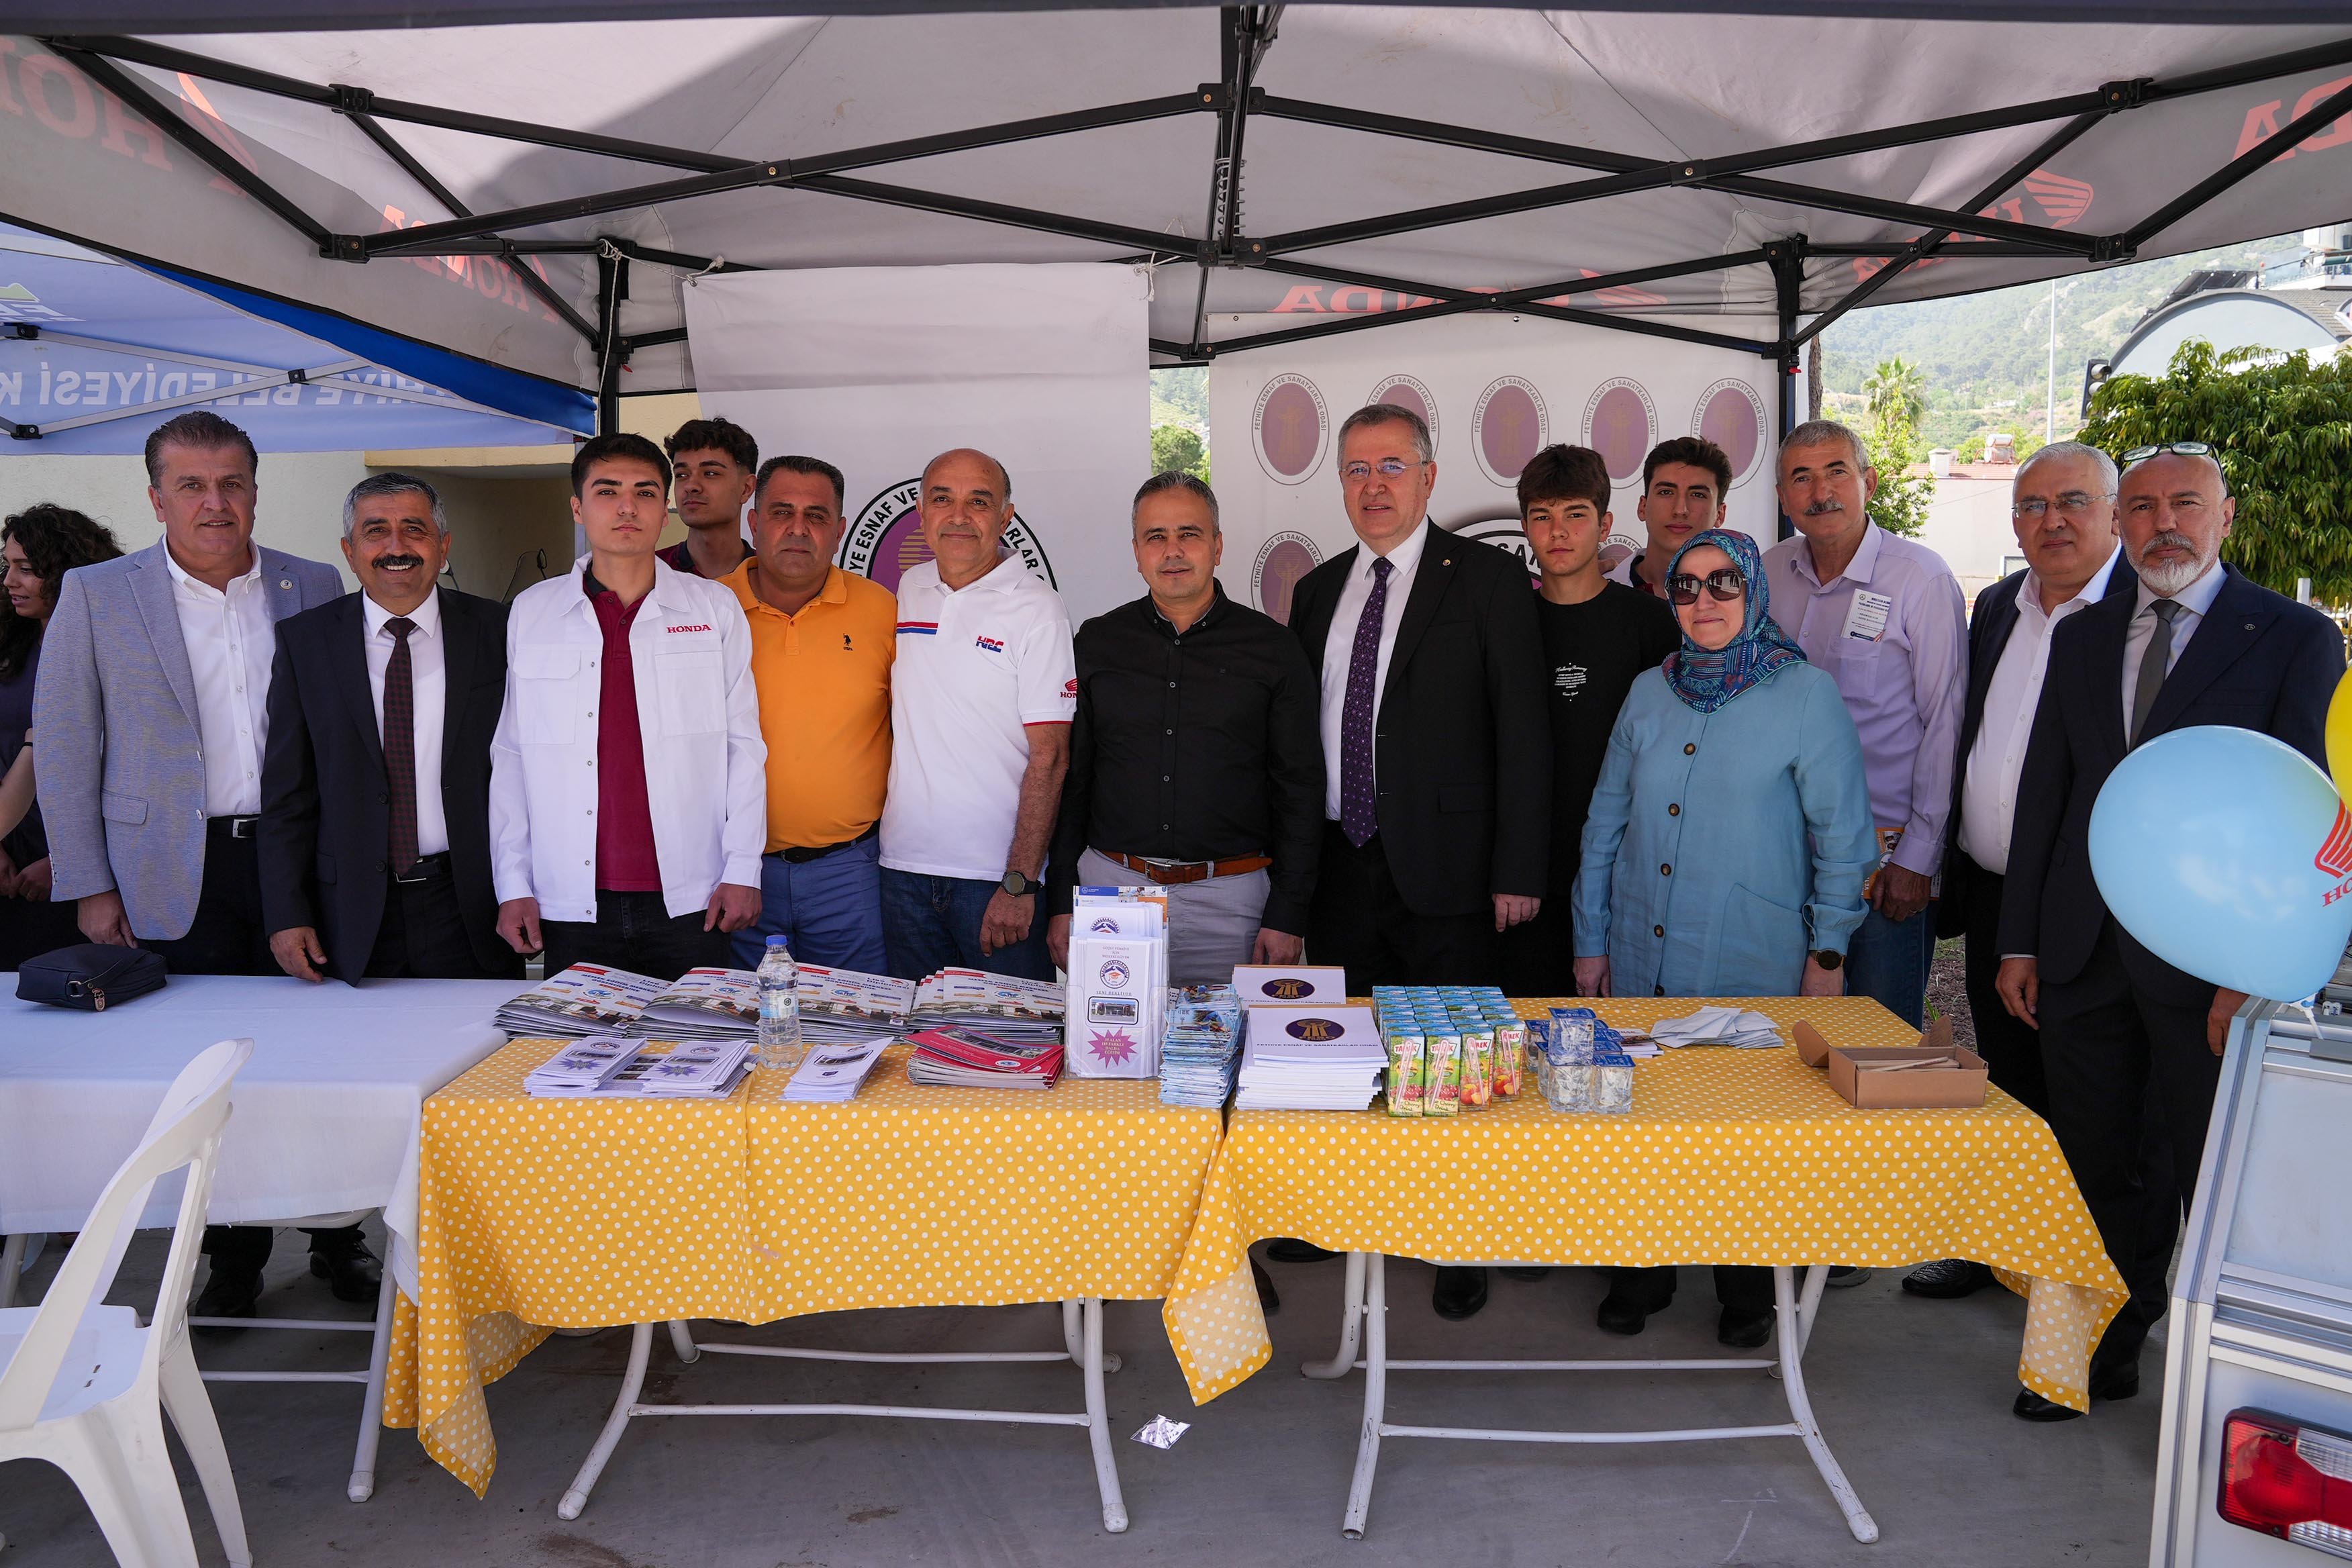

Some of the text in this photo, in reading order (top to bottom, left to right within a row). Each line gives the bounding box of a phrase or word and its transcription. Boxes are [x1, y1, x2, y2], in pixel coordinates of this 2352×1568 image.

[1261, 382, 1277, 402] ESNAF
[1276, 377, 1285, 385] VE
[1371, 384, 1387, 403] ESNAF
[1481, 385, 1497, 404] ESNAF
[1591, 386, 1608, 405] ESNAF
[1607, 381, 1616, 389] VE
[1700, 387, 1716, 407] ESNAF
[858, 501, 893, 550] ESNAF
[893, 487, 919, 505] VE
[1006, 521, 1039, 570] RLAR
[1261, 540, 1276, 559] ESNAF
[667, 624, 712, 634] HONDA
[975, 636, 1004, 653] HRC
